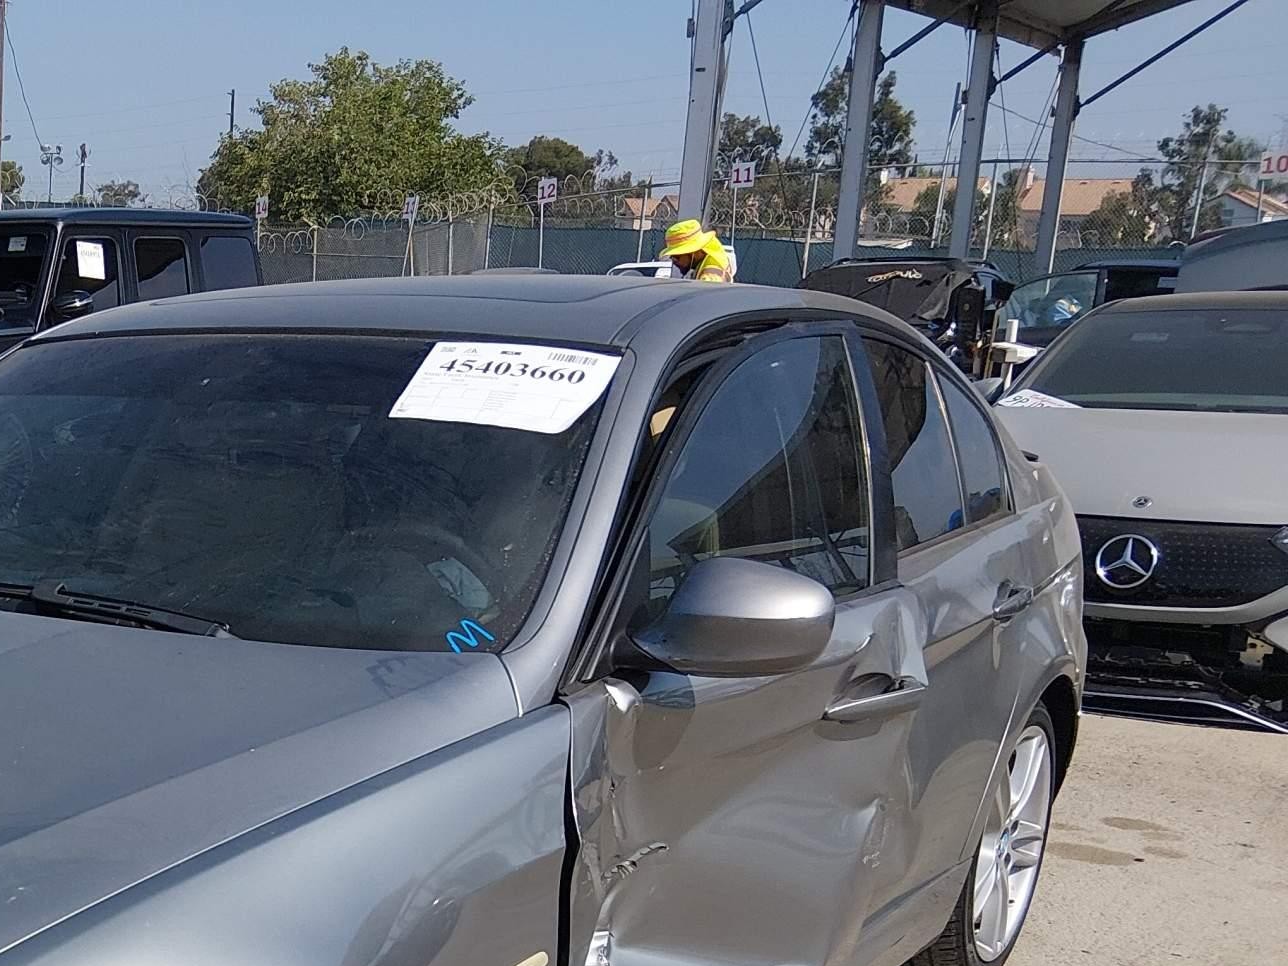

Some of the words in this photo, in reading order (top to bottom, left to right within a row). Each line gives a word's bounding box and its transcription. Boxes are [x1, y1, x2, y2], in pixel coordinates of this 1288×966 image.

[1261, 154, 1288, 174] 10
[732, 166, 752, 184] 11
[539, 183, 556, 200] 12
[256, 200, 267, 215] 14
[439, 358, 586, 385] 45403660
